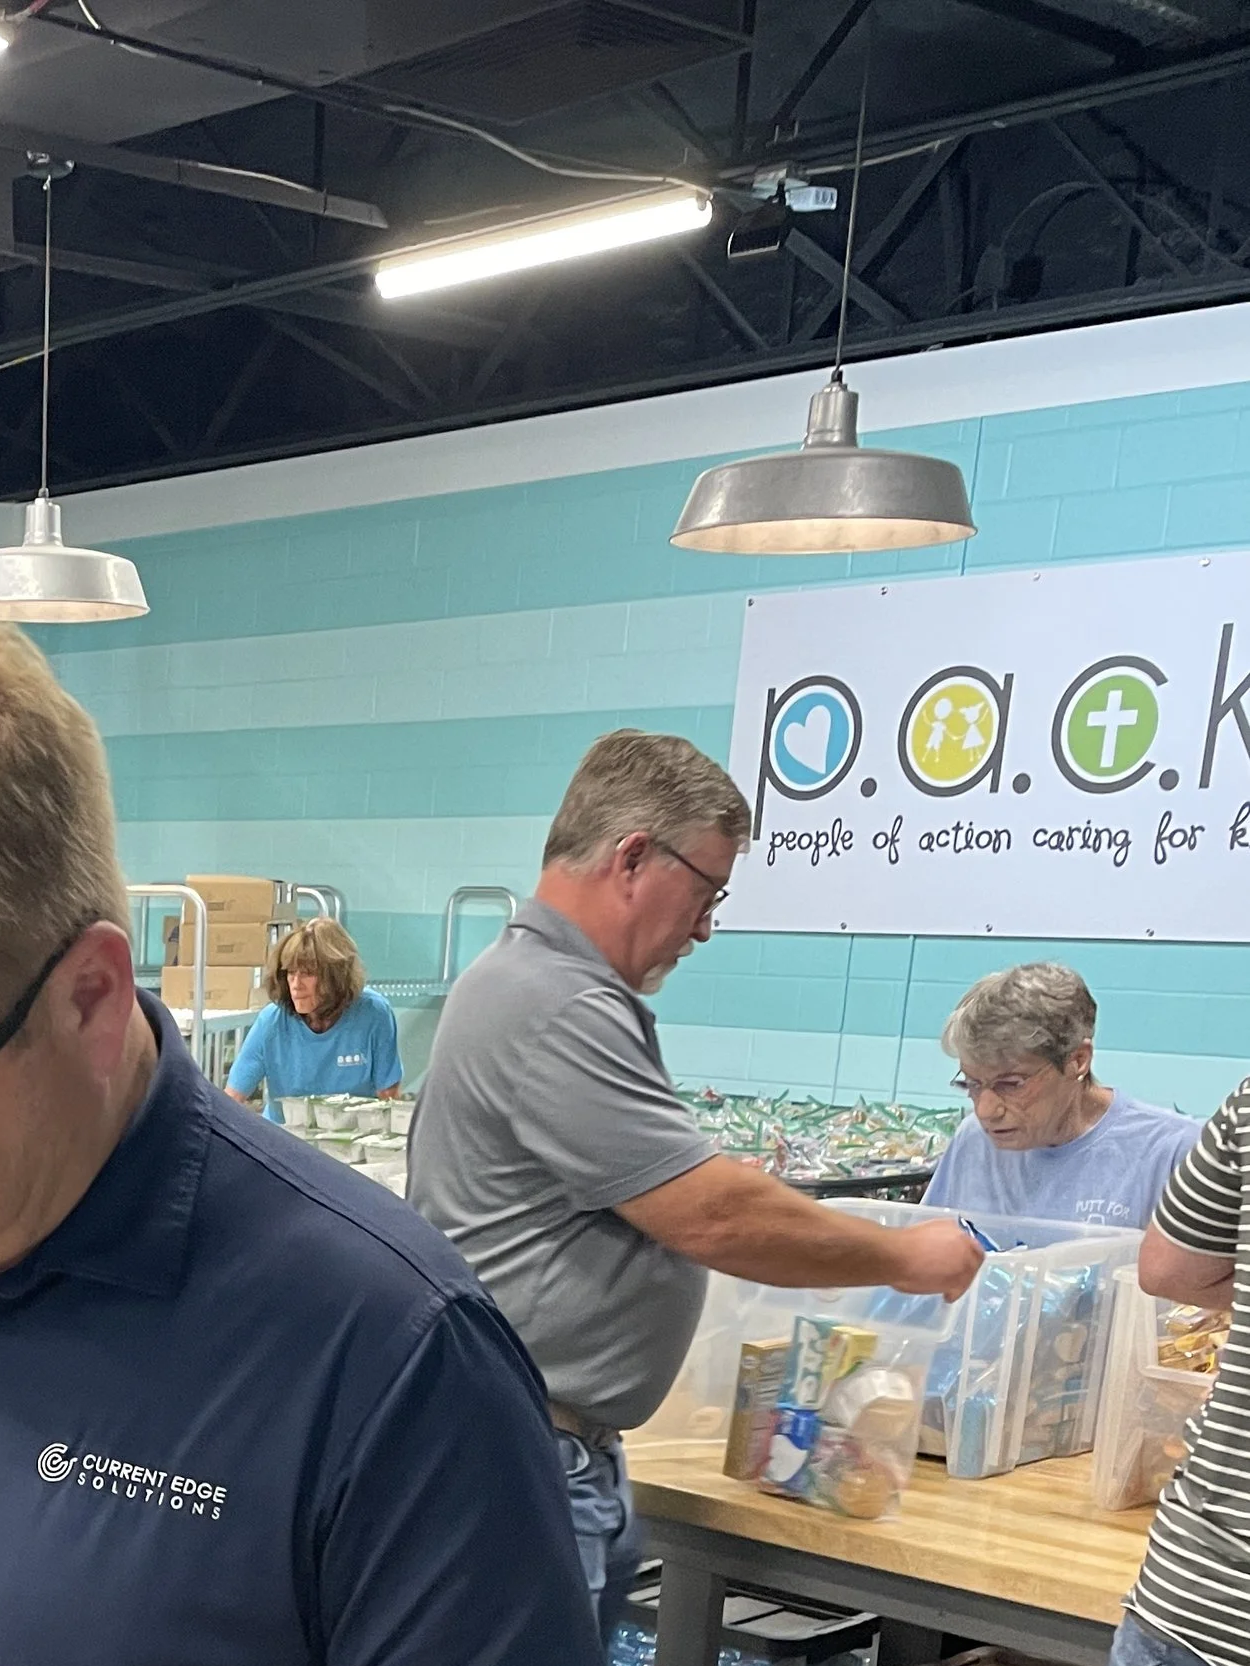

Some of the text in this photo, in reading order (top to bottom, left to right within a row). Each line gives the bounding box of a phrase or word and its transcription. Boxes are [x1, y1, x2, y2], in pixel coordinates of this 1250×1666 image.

[766, 817, 854, 867] people
[872, 814, 903, 866] of
[919, 818, 1012, 855] action
[1033, 819, 1132, 868] caring
[1154, 810, 1205, 868] for
[77, 1472, 221, 1520] SOLUTIONS
[82, 1454, 227, 1504] CURRENT EDGE
